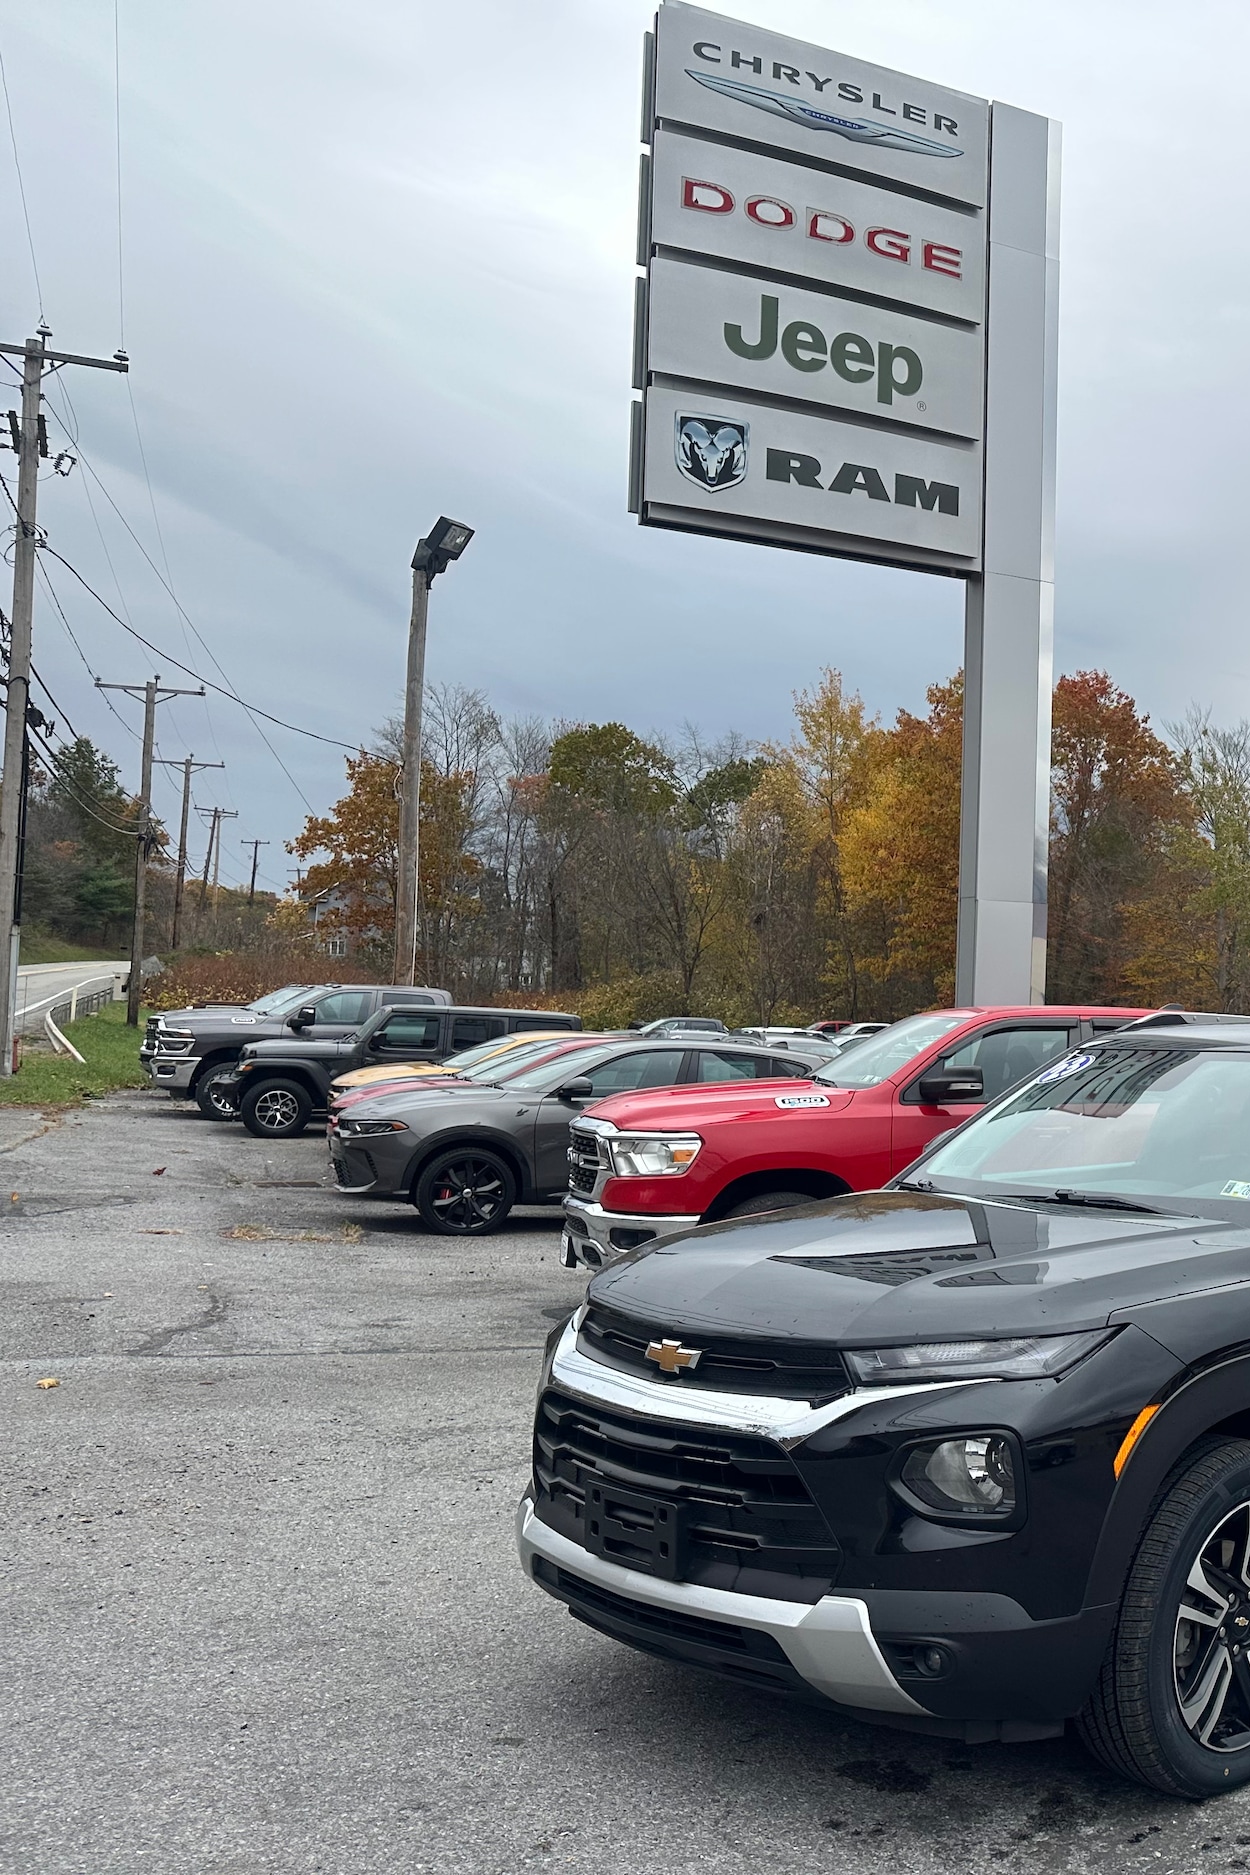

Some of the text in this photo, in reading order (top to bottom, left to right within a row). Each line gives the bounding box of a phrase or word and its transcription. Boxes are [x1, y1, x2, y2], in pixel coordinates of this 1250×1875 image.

[693, 41, 959, 137] CHRYSLER
[681, 176, 963, 280] DODGE
[724, 294, 924, 404] Jeep
[766, 447, 960, 517] RAM
